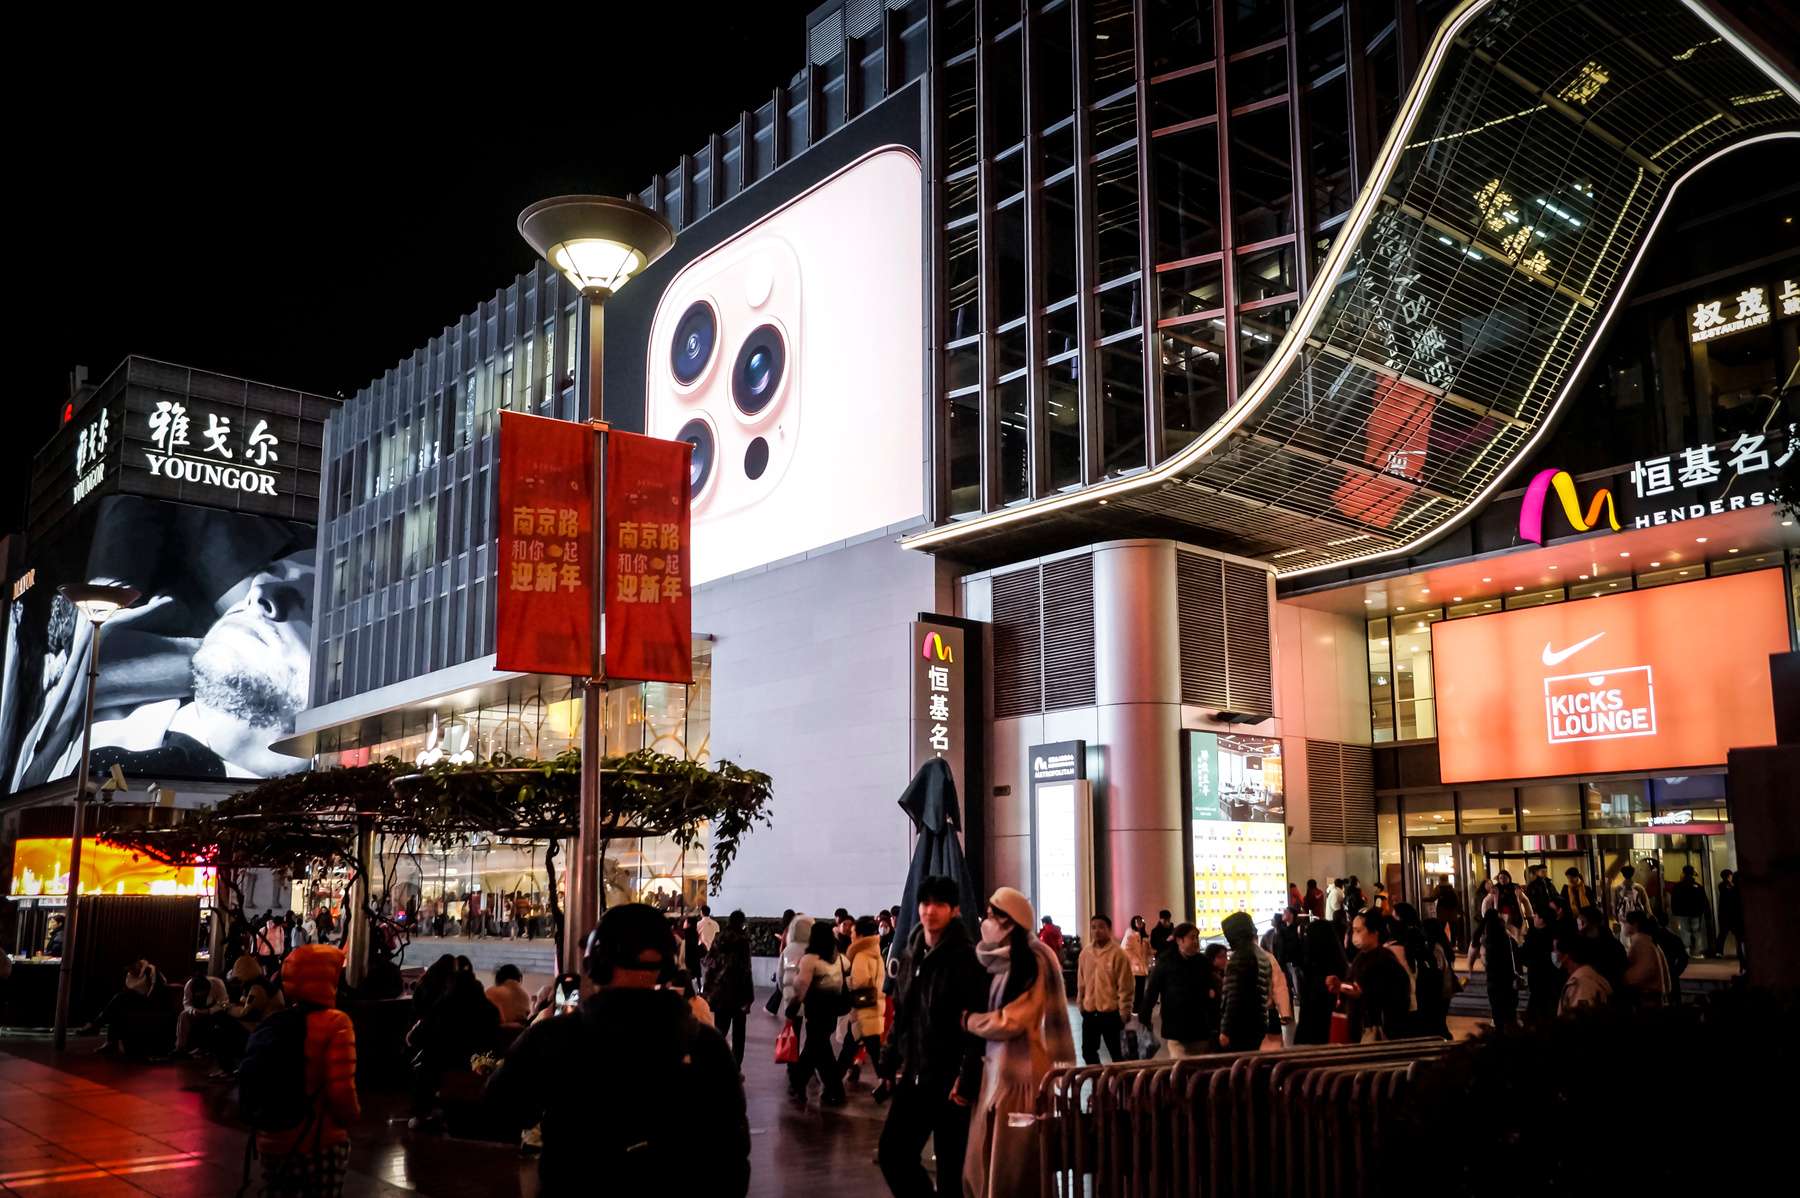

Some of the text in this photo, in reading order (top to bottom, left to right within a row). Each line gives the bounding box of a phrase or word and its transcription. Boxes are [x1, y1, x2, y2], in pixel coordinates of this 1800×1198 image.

[1692, 287, 1769, 330] 权茂
[1691, 312, 1770, 342] RESTAURANT
[148, 400, 279, 466] 雅戈尔
[145, 453, 279, 496] YOUNGOR
[513, 506, 579, 538] 南京路
[618, 521, 680, 551] 南京路
[510, 562, 582, 594] 迎新年
[616, 574, 683, 604] 迎新年
[928, 664, 950, 758] 恒基名
[1551, 689, 1624, 717] KICKS
[1552, 707, 1650, 737] LOUNGE
